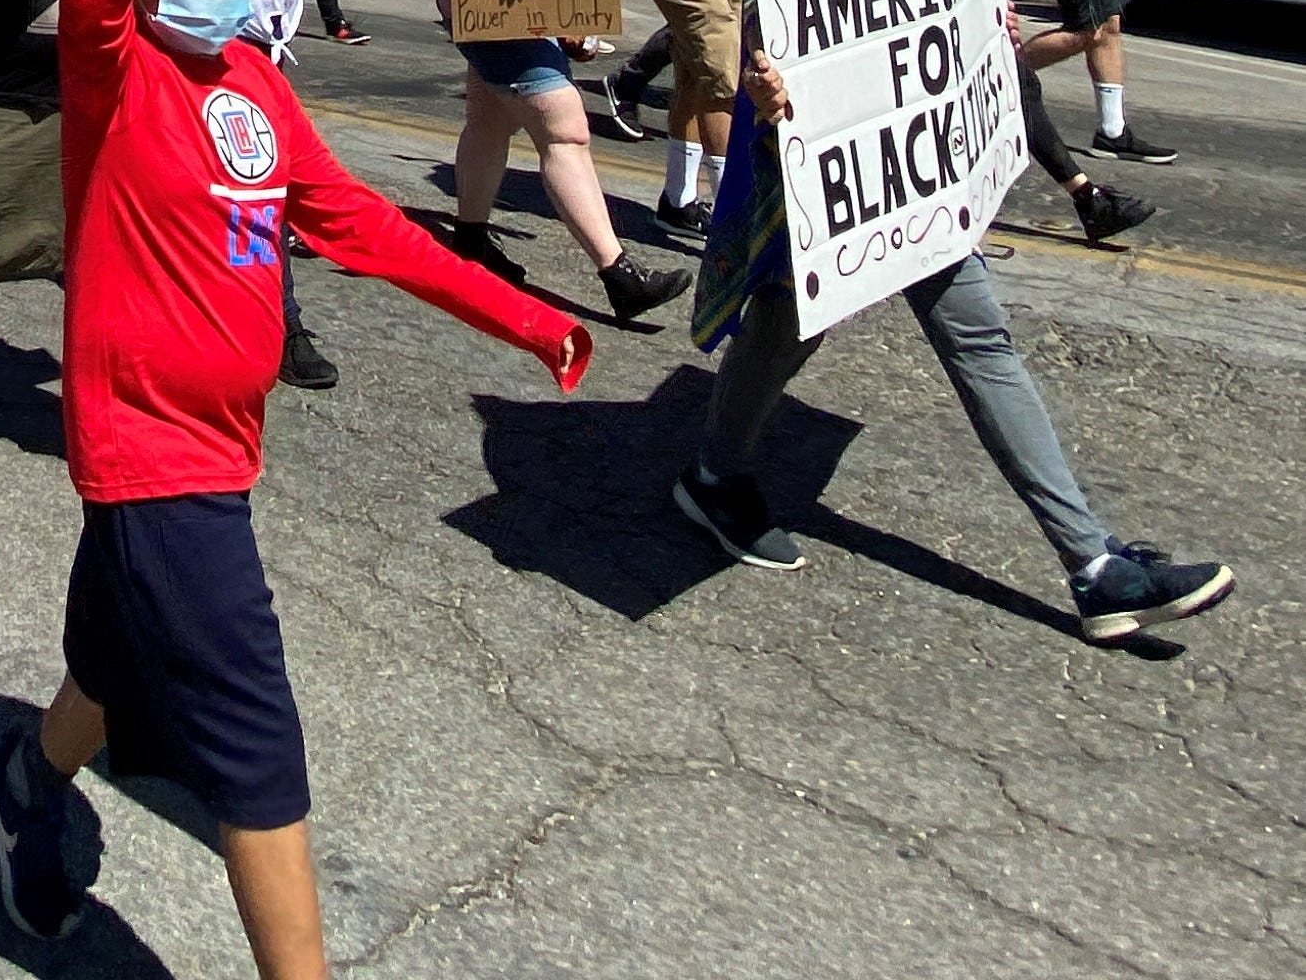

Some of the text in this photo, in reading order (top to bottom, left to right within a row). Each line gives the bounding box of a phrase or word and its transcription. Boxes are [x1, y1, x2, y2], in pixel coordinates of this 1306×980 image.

[526, 6, 545, 26] in
[888, 15, 965, 108] FOR
[818, 100, 959, 239] BLACK
[960, 52, 1000, 176] LIVES
